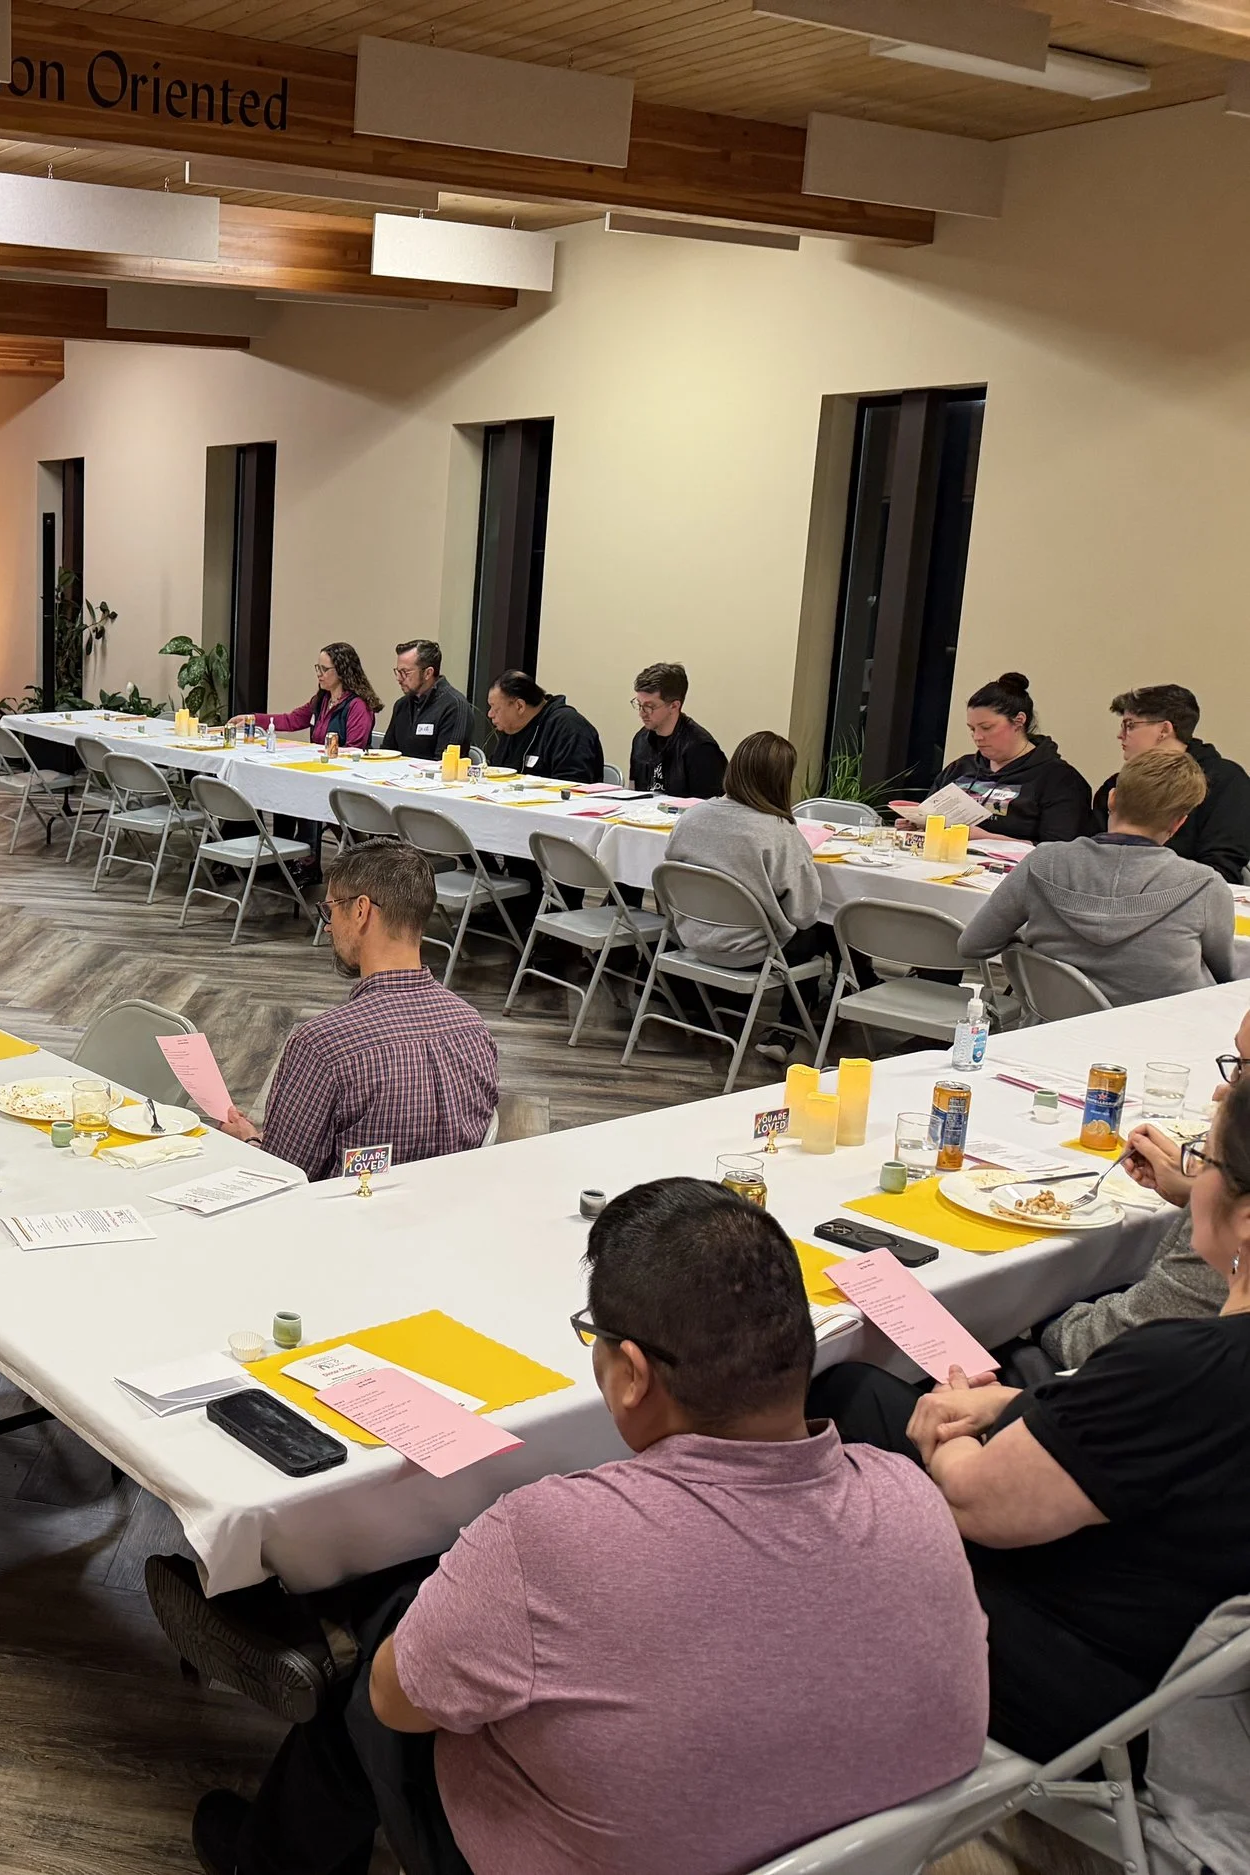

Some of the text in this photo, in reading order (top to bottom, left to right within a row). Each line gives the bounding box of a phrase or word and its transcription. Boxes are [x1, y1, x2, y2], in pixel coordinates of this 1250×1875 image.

[87, 50, 288, 131] Oriented
[757, 1112, 787, 1124] YOU ARE
[757, 1121, 786, 1134] LOVED
[350, 1150, 386, 1163] YOU ARE
[349, 1160, 385, 1173] LOVED
